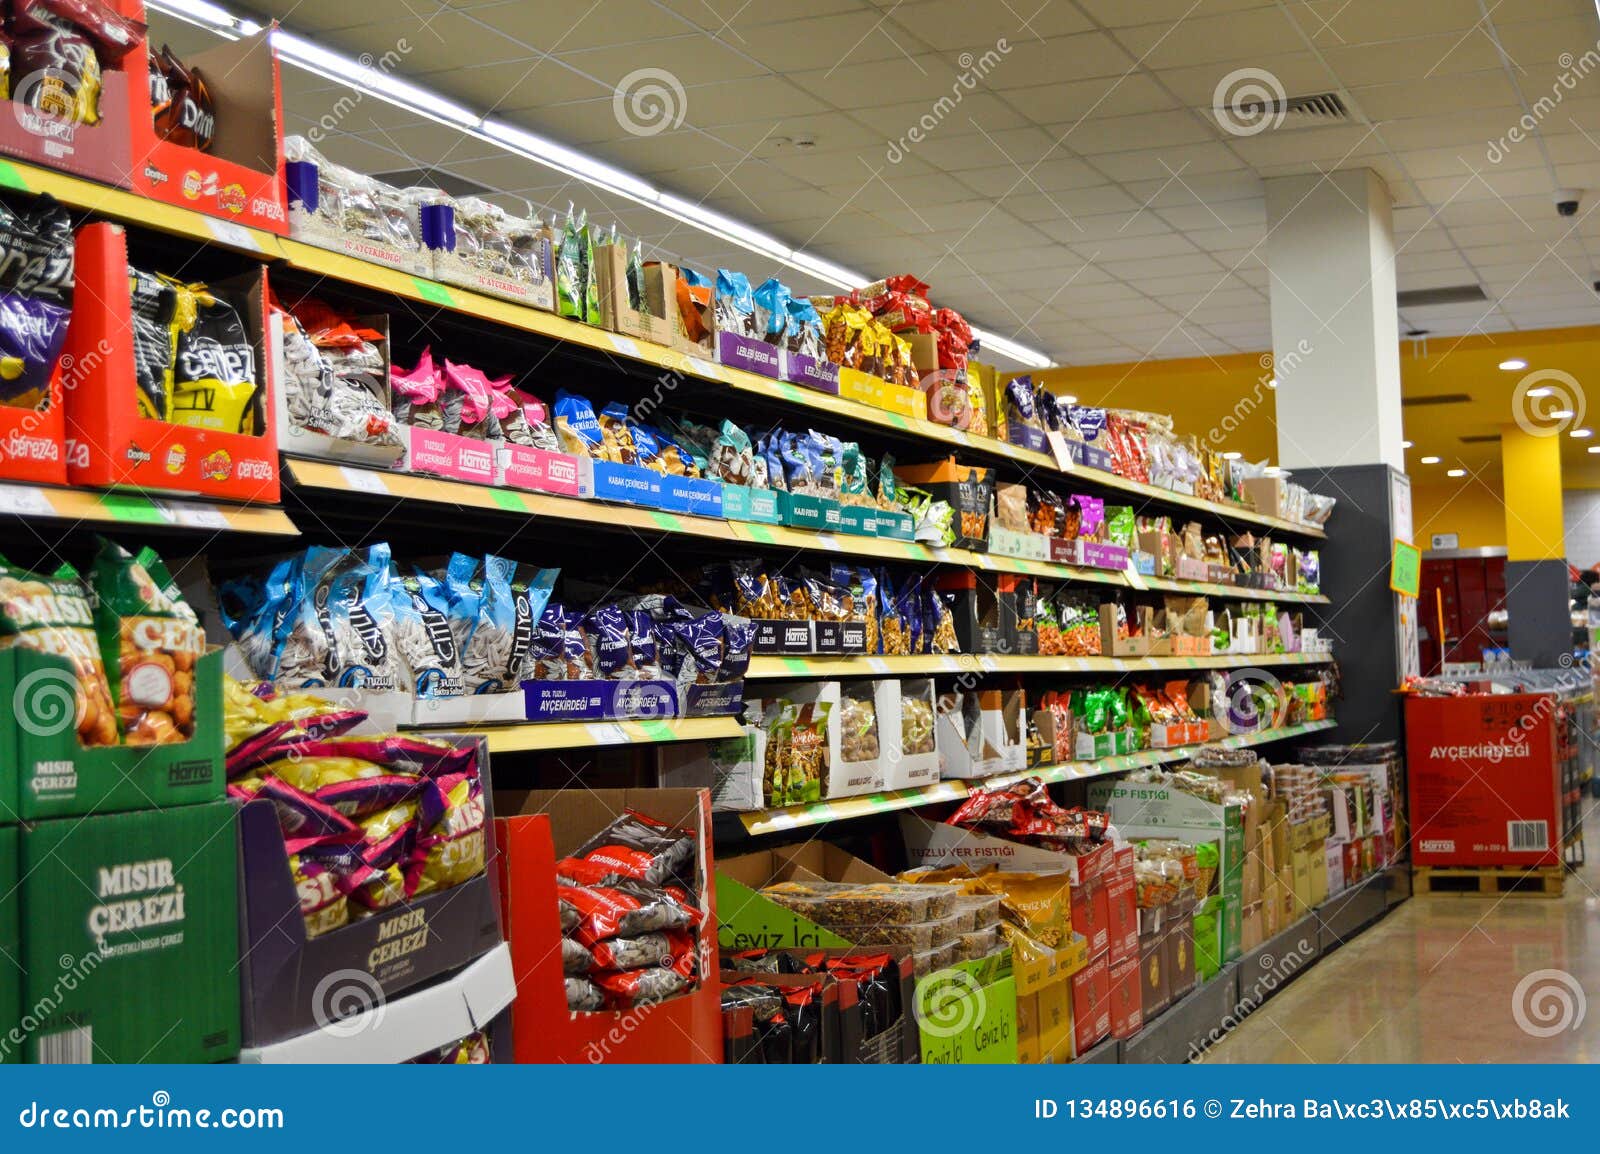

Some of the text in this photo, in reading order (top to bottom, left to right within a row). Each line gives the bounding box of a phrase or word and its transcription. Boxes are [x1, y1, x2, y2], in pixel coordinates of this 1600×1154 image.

[540, 696, 588, 715] AYÇEKİRDEĞİ
[36, 760, 75, 775] MISIR
[31, 771, 78, 794] ÇEREZİ
[1090, 789, 1127, 799] ANTEP
[911, 846, 1015, 858] TUZLU YER FISTIĞI
[99, 858, 175, 898] MISIR
[88, 883, 185, 943] ÇEREZİ
[377, 907, 426, 943] MISIR
[367, 923, 430, 973] ÇEREZİ
[717, 924, 785, 948] Ceviz
[975, 1020, 999, 1052] Ceviz
